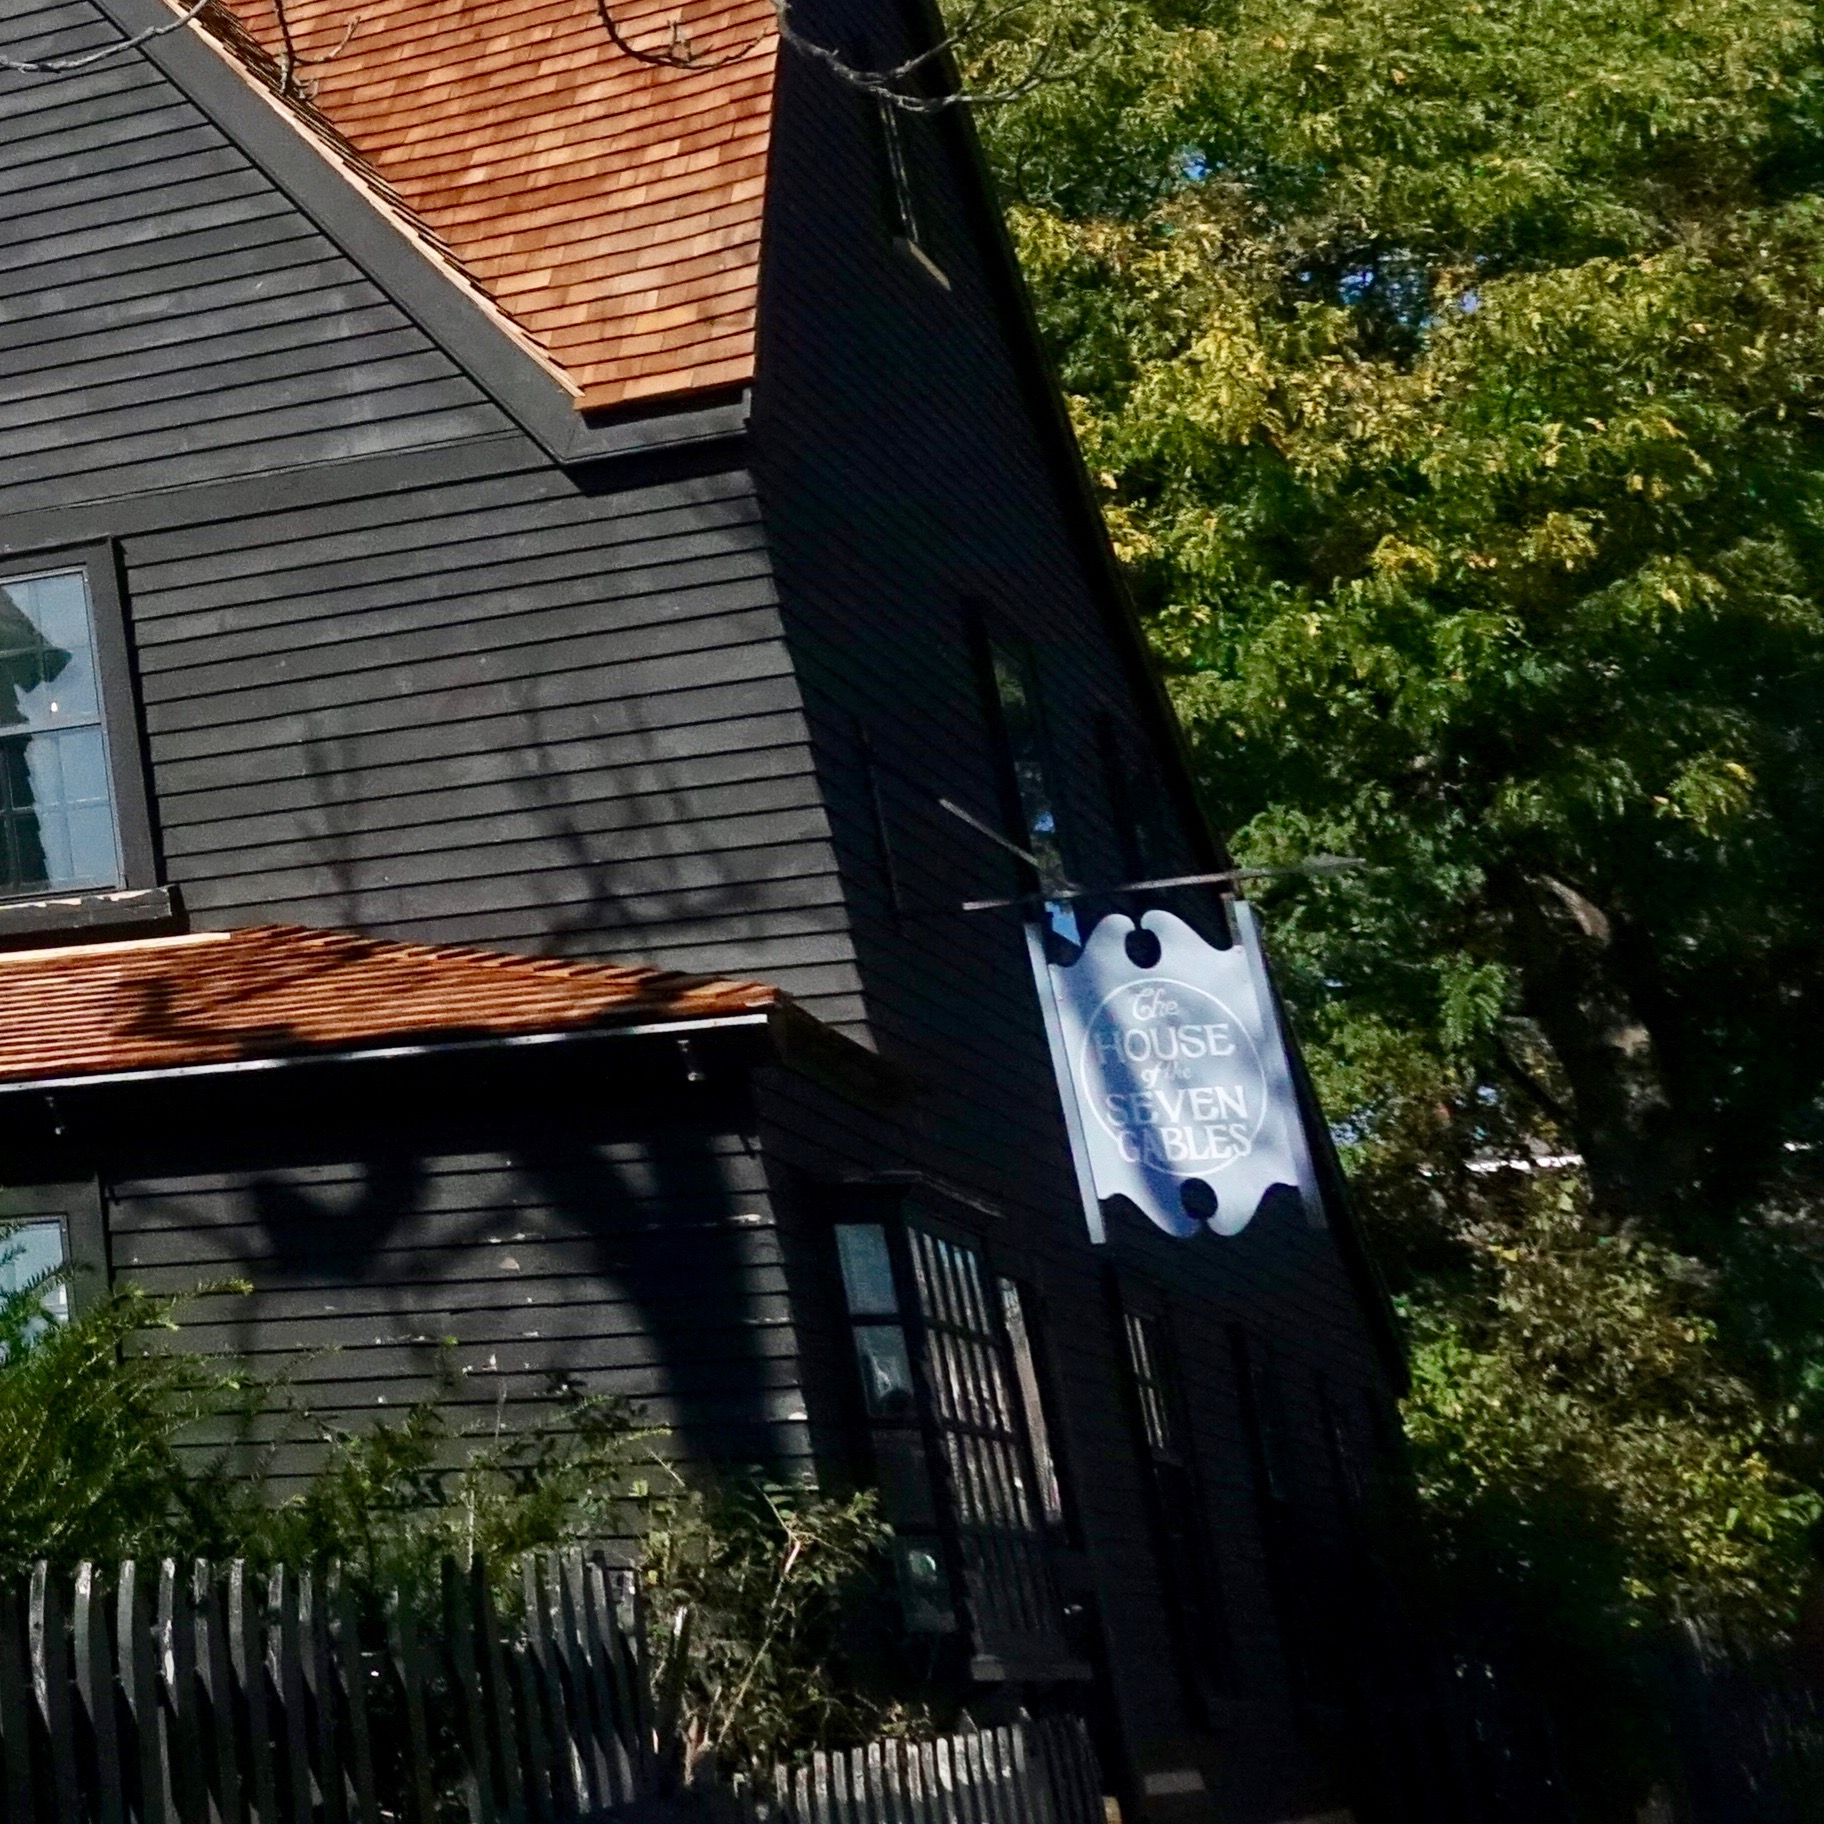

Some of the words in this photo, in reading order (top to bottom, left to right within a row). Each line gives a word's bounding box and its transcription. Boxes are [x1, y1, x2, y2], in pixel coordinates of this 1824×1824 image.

[1132, 988, 1179, 1021] The
[1095, 1023, 1236, 1063] HOUSE
[1105, 1085, 1248, 1126] SEVEN
[1116, 1123, 1252, 1163] GABLES
